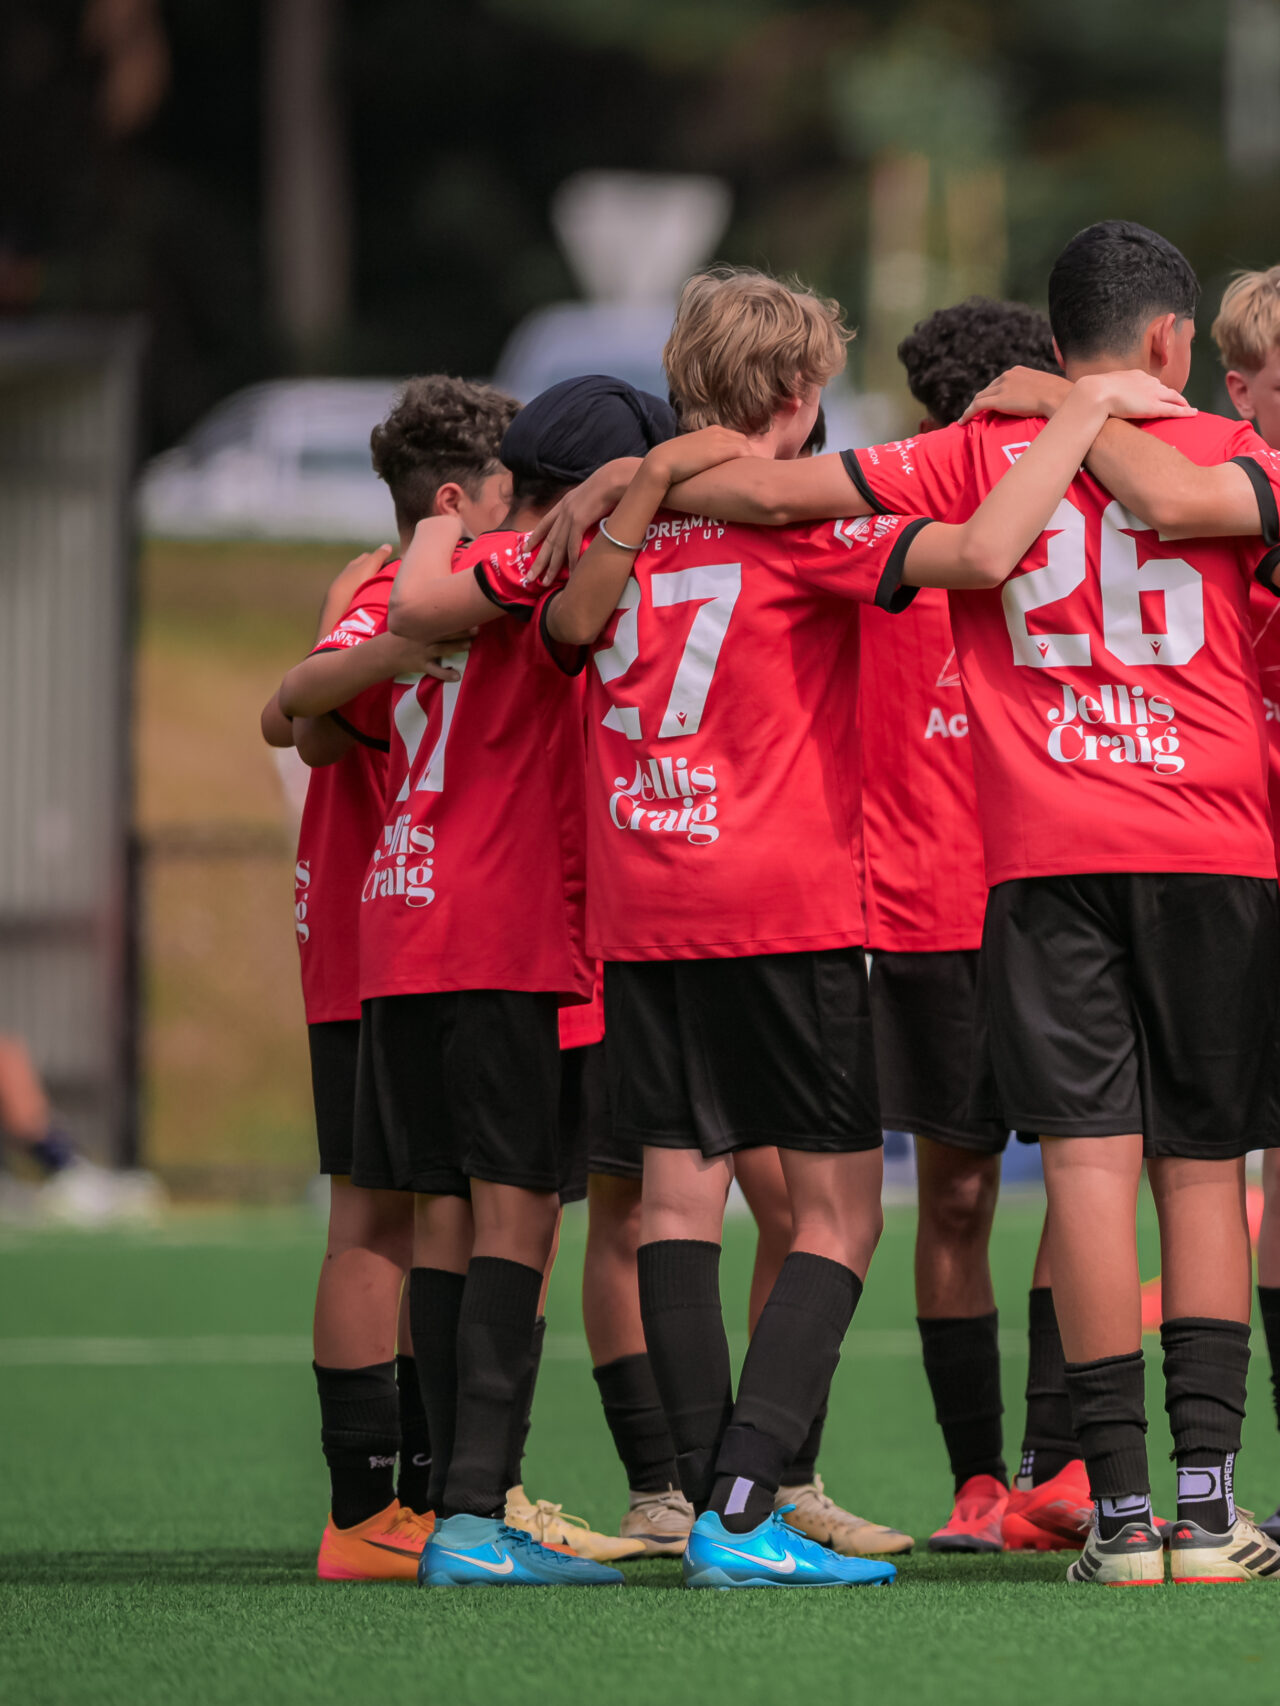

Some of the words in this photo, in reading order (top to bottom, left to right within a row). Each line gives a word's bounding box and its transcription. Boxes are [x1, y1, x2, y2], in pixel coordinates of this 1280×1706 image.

[676, 533, 690, 546] IT
[703, 528, 725, 540] UP
[1001, 497, 1205, 668] 26
[593, 562, 742, 741] 27
[1046, 684, 1175, 726] Jellis
[1046, 724, 1186, 776] Craig
[613, 756, 717, 802] Jellis
[608, 795, 721, 846] Craig
